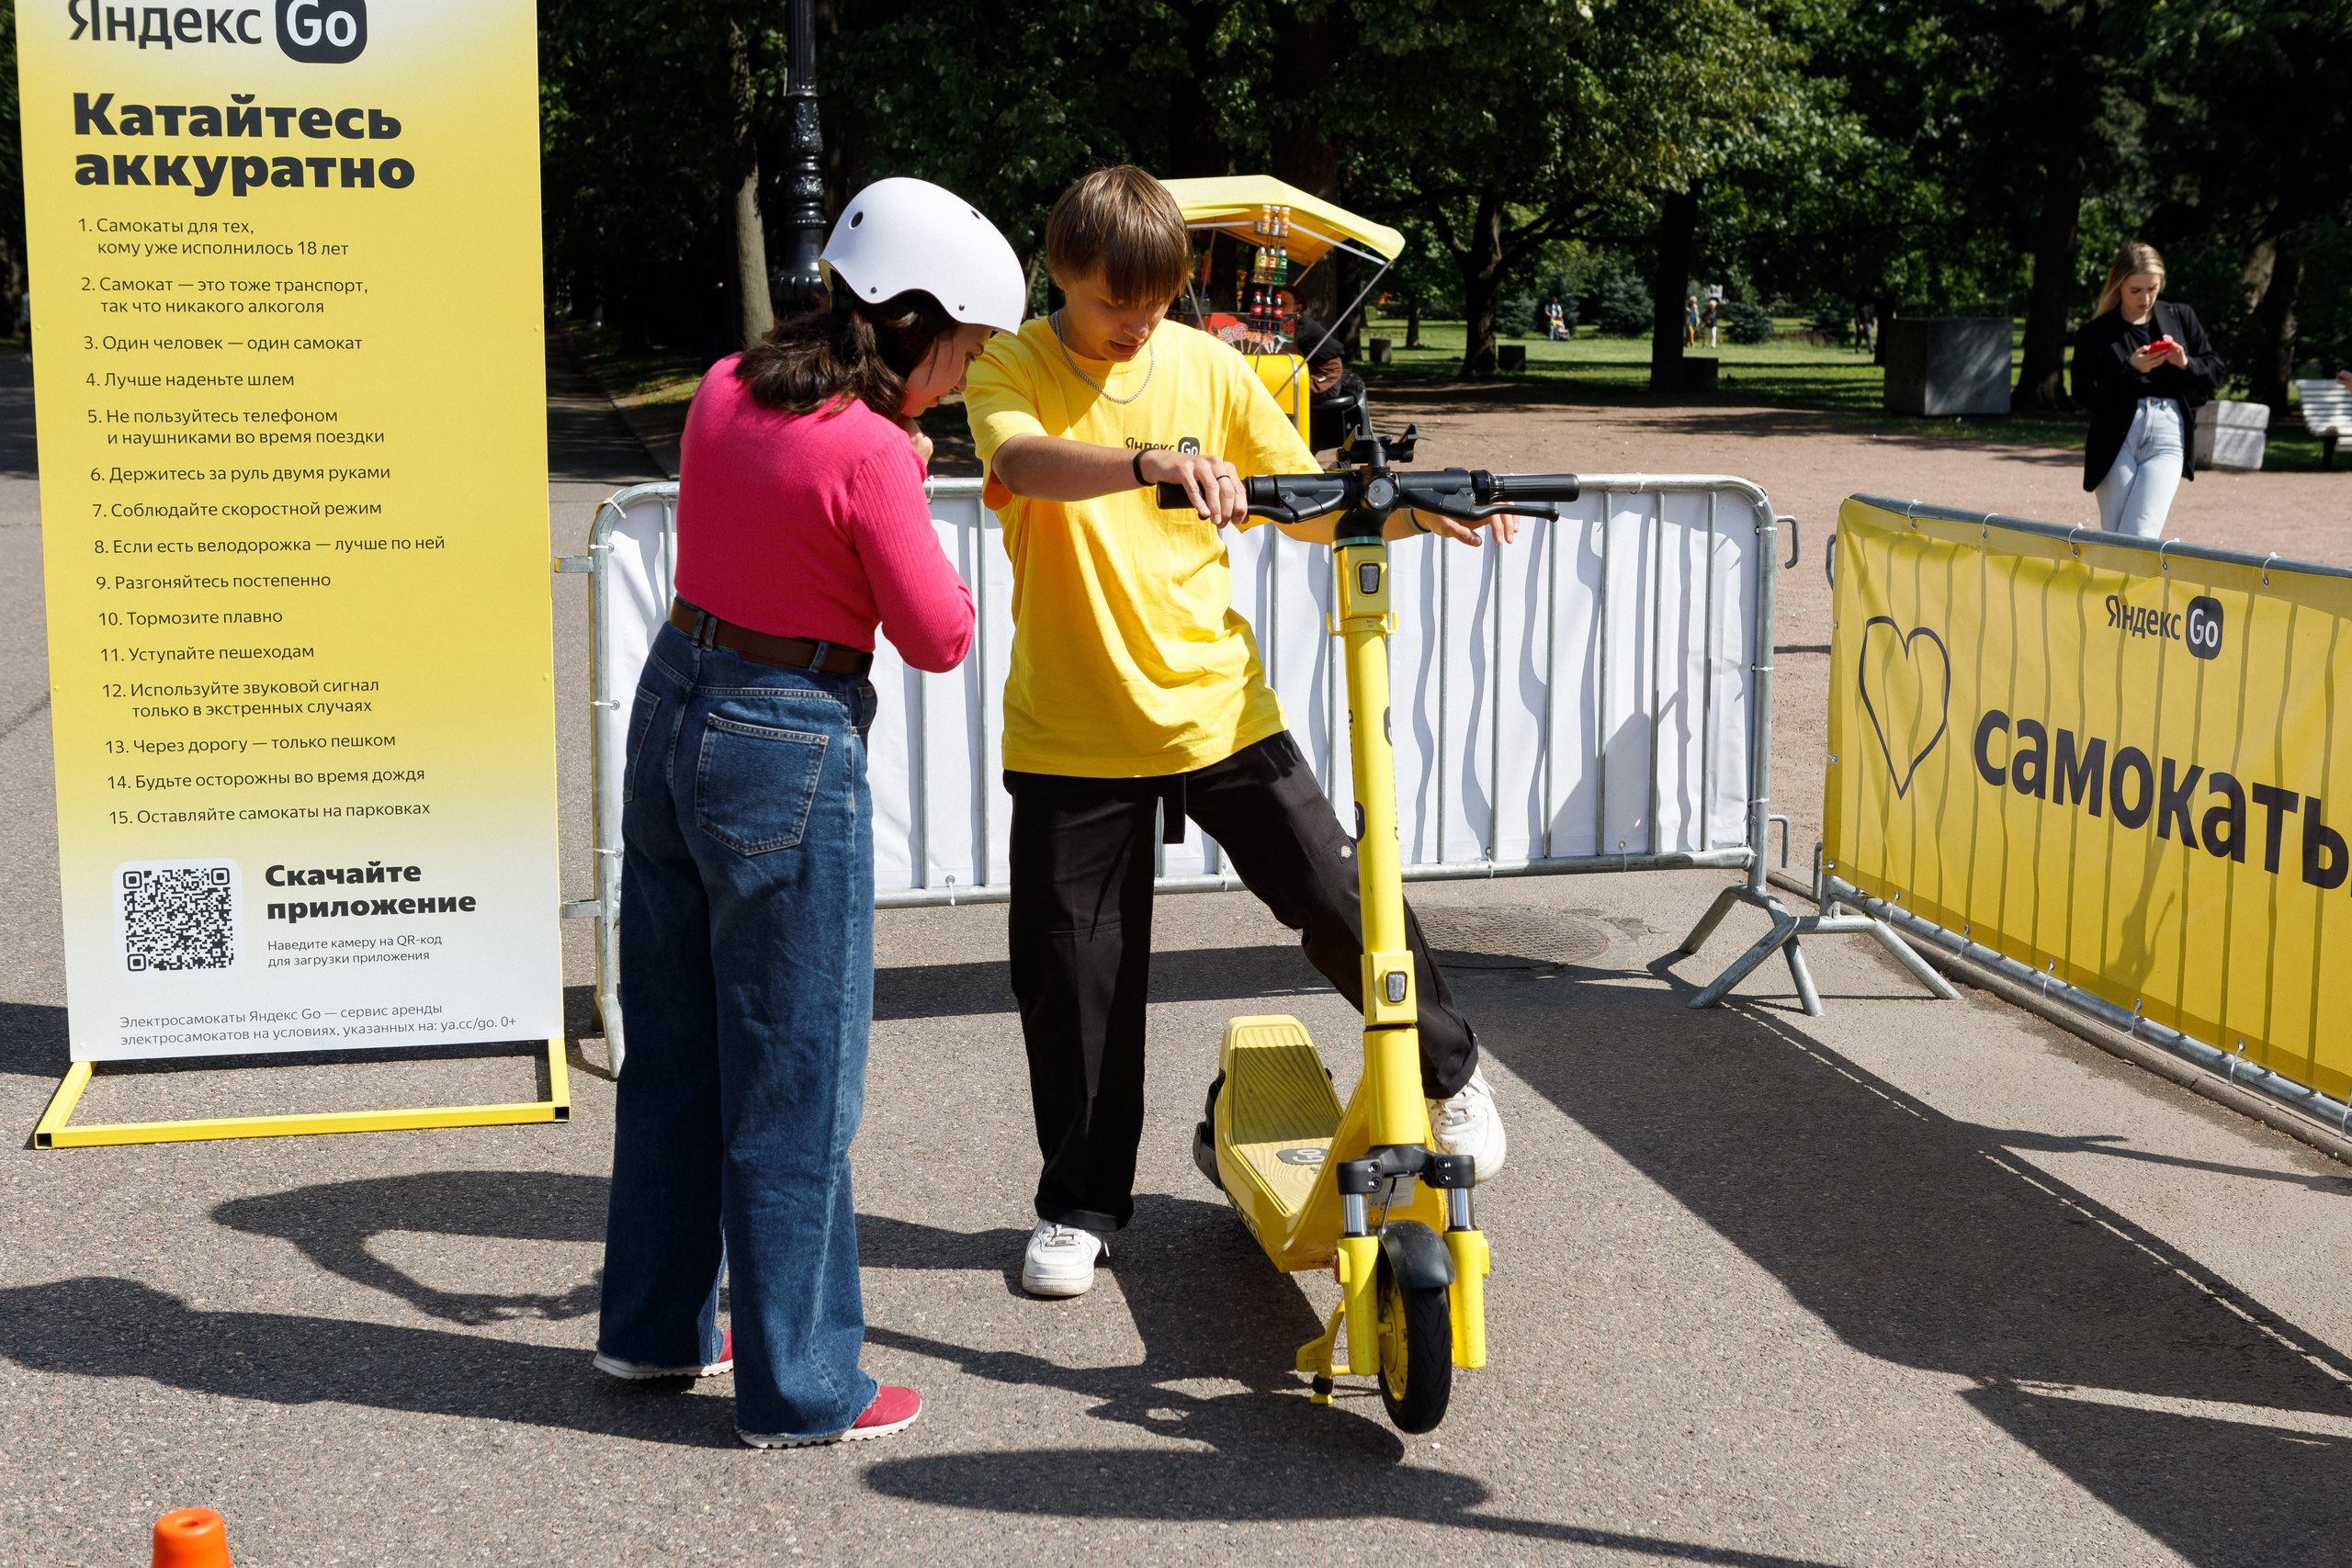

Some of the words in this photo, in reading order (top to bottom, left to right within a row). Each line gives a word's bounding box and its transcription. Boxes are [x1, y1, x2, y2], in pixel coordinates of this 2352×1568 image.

[67, 0, 262, 51] Яндекс
[286, 0, 357, 48] Go
[73, 92, 402, 140] Катайтесь
[74, 153, 415, 197] аккуратно
[78, 218, 93, 232] 1.
[96, 218, 184, 232] Самокаты
[187, 221, 218, 235] для
[221, 222, 254, 235] тех,
[97, 243, 141, 257] кому
[144, 243, 178, 257] уже
[182, 243, 294, 255] исполнилось
[298, 241, 317, 255] 18
[321, 244, 349, 255] лет
[81, 276, 96, 291] 2.
[99, 276, 174, 291] Самокат
[198, 280, 225, 292] это
[229, 280, 271, 292] тоже
[274, 280, 368, 295] транспорт,
[100, 301, 129, 313] так
[132, 301, 162, 313] что
[165, 301, 244, 313] никакого
[248, 302, 324, 313] алкоголя
[84, 335, 98, 350] 3.
[102, 335, 149, 353] Один
[153, 338, 223, 350] человек
[247, 339, 289, 353] один
[293, 339, 363, 350] самокат
[85, 372, 100, 387] 4.
[104, 372, 162, 389] Лучше
[165, 375, 243, 389] наденьте
[247, 375, 294, 387] шлем
[87, 409, 102, 423] 5.
[107, 409, 130, 423] Не
[133, 409, 239, 426] пользуйтесь
[242, 408, 338, 425] телефоном
[107, 434, 118, 445] и
[122, 433, 232, 447] наушниками
[235, 433, 255, 444] во
[259, 433, 311, 446] время
[316, 432, 385, 446] поездки
[1181, 441, 1199, 456] Go
[90, 467, 106, 481] 6.
[108, 467, 206, 484] Держитесь
[209, 469, 227, 480] за
[231, 468, 269, 483] руль
[272, 468, 324, 483] двумя
[329, 468, 390, 482] руками
[92, 503, 107, 518] 7.
[111, 502, 218, 519] Соблюдайте
[221, 501, 321, 519] скоростной
[324, 503, 381, 518] режим
[94, 539, 109, 554] 8.
[113, 539, 153, 554] Если
[157, 542, 194, 553] есть
[198, 540, 311, 555] велодорожка
[334, 539, 388, 554] лучше
[391, 539, 412, 550] по
[415, 535, 445, 549] ней
[96, 576, 111, 591] 9.
[115, 574, 230, 590] Разгоняйтесь
[232, 576, 332, 588] постепенно
[98, 612, 123, 626] 10.
[126, 611, 220, 628] Тормозите
[223, 612, 283, 624] плавно
[2105, 594, 2182, 641] Яндекс
[2188, 606, 2220, 649] Go
[100, 648, 125, 662] 11.
[128, 646, 215, 664] Уступайте
[219, 647, 314, 660] пешеходам
[102, 683, 127, 698] 12.
[130, 681, 240, 699] Используйте
[243, 679, 319, 697] звуковой
[322, 681, 379, 693] сигнал
[131, 705, 189, 717] только
[193, 705, 202, 716] в
[206, 703, 304, 718] экстренных
[307, 701, 372, 716] случаях
[105, 739, 130, 754] 13.
[133, 739, 185, 756] Через
[187, 739, 248, 754] дорогу
[271, 738, 327, 750] только
[331, 736, 396, 748] пешком
[107, 775, 131, 789] 14.
[135, 774, 192, 792] Будьте
[195, 773, 290, 788] осторожны
[294, 773, 314, 784] во
[317, 772, 368, 785] время
[371, 770, 424, 784] дождя
[108, 810, 133, 825] 15.
[137, 807, 235, 824] Оставляйте
[239, 807, 319, 820] самокаты
[322, 807, 342, 818] на
[345, 804, 431, 819] парковках
[265, 860, 422, 887] Скачайте
[266, 896, 477, 924] приложение
[267, 940, 328, 952] Наведите
[331, 939, 377, 950] камеру
[379, 938, 394, 946] на
[396, 934, 443, 947] QR-код
[267, 958, 290, 969] для
[293, 955, 350, 967] загрузки
[352, 952, 430, 965] приложения
[119, 1013, 245, 1029] Электросамокаты
[249, 1010, 299, 1023] Яндекс
[301, 1008, 322, 1020] Go
[340, 1007, 389, 1020] сервис
[391, 1005, 443, 1018] аренды
[120, 1031, 250, 1046] электросамокатов
[254, 1030, 269, 1040] на
[272, 1027, 340, 1041] условиях,
[343, 1023, 415, 1038] указанных
[418, 1022, 437, 1032] на:
[440, 1017, 498, 1033] ya.cc/go.
[500, 1015, 516, 1028] 0+
